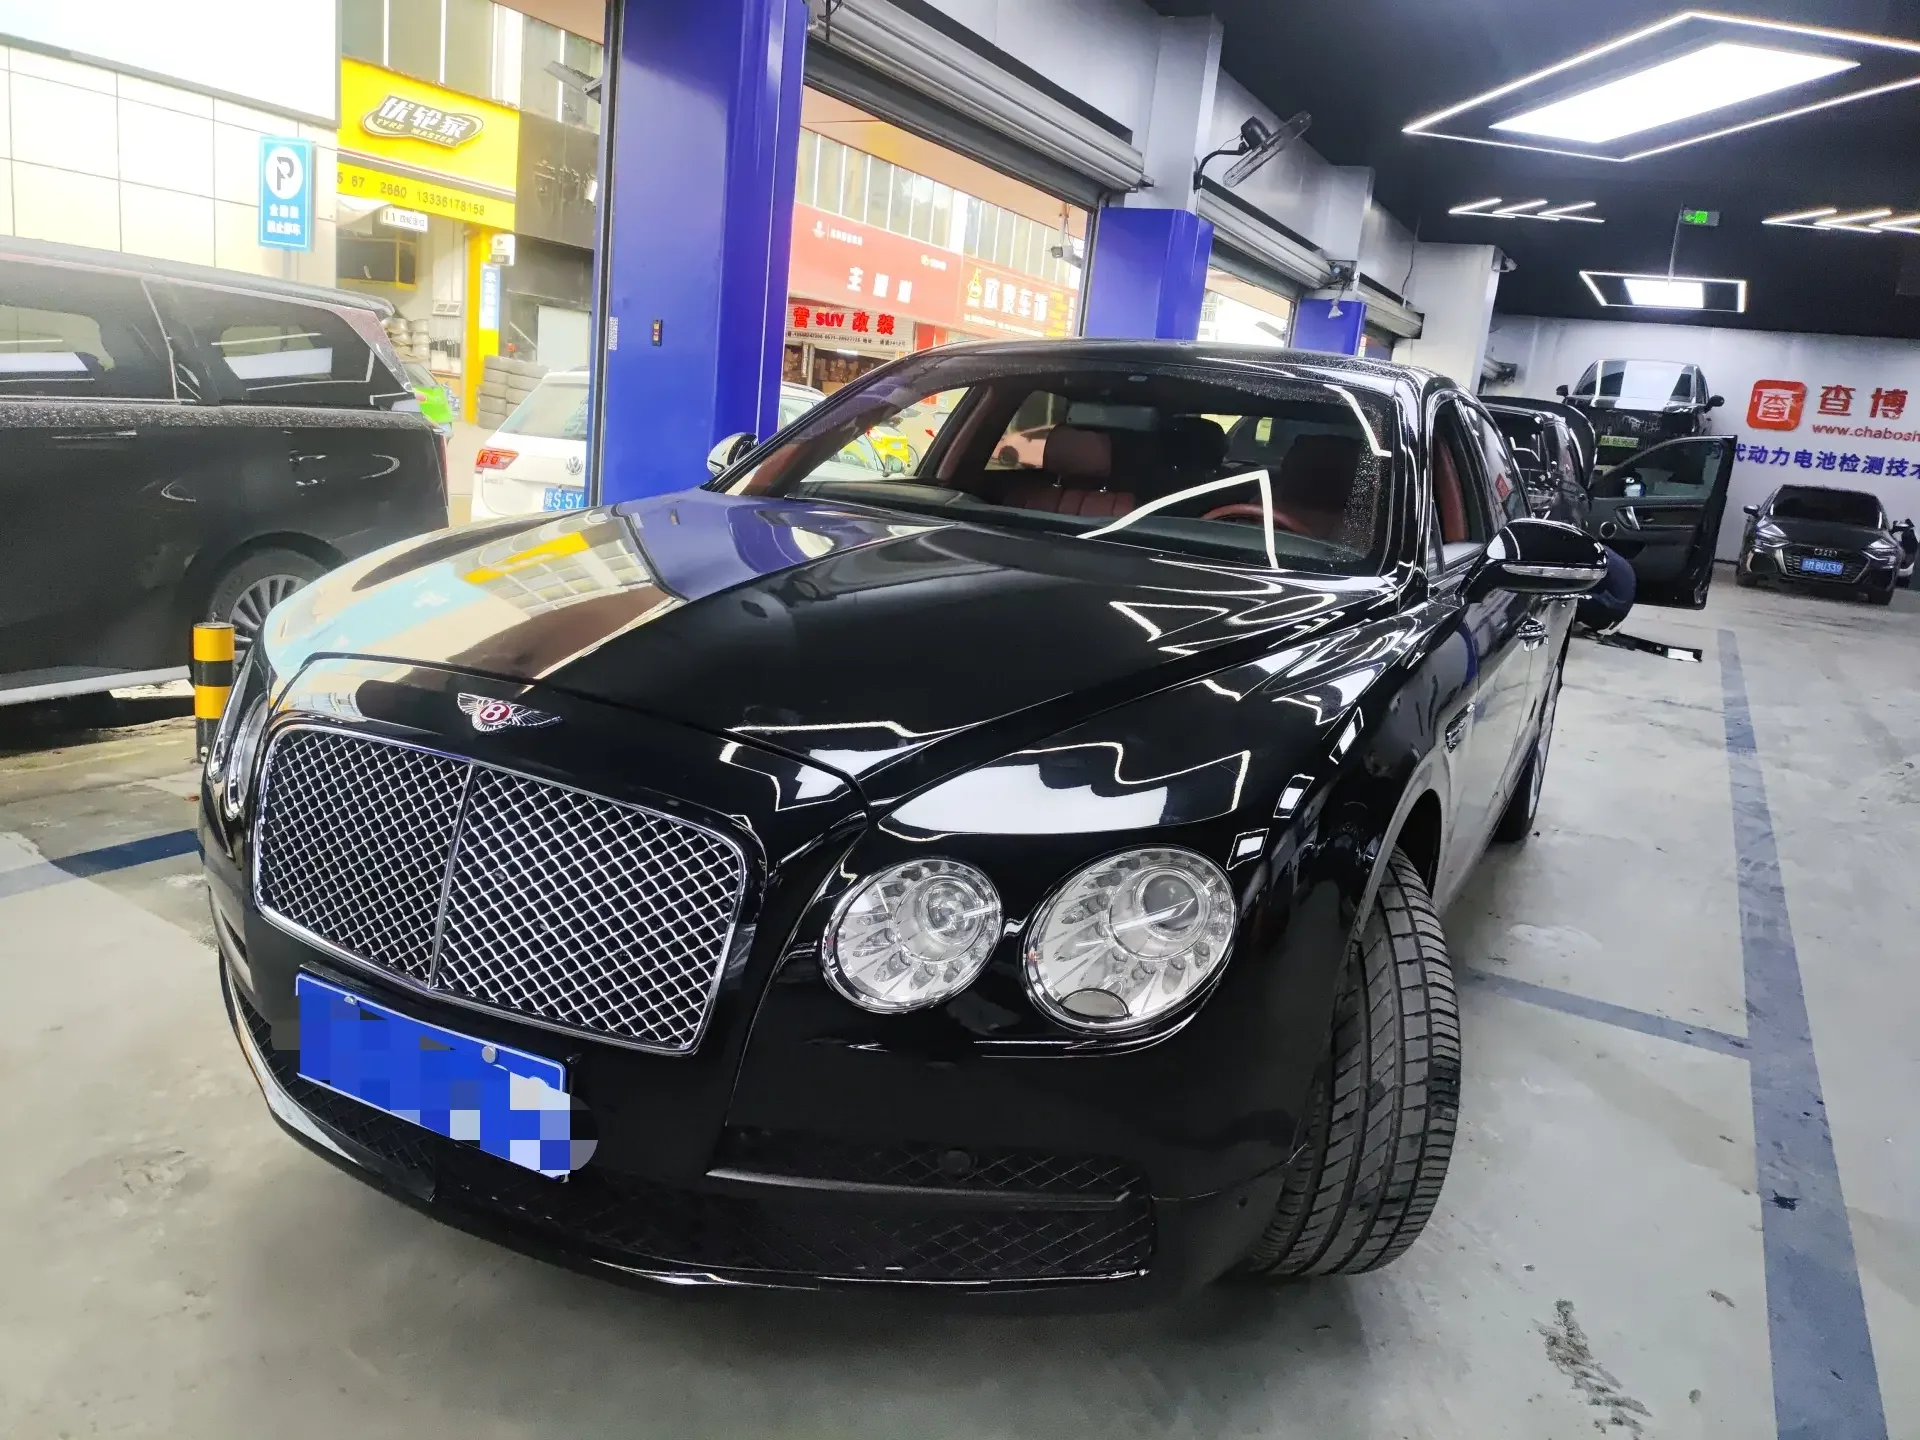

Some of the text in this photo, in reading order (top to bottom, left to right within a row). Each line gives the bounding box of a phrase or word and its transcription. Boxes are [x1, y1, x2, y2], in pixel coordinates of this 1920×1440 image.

[376, 118, 455, 144] TYRE MASTER
[378, 97, 471, 138] 优轮家
[792, 305, 895, 335] 营 SUV 改装
[1817, 384, 1908, 420] 查博
